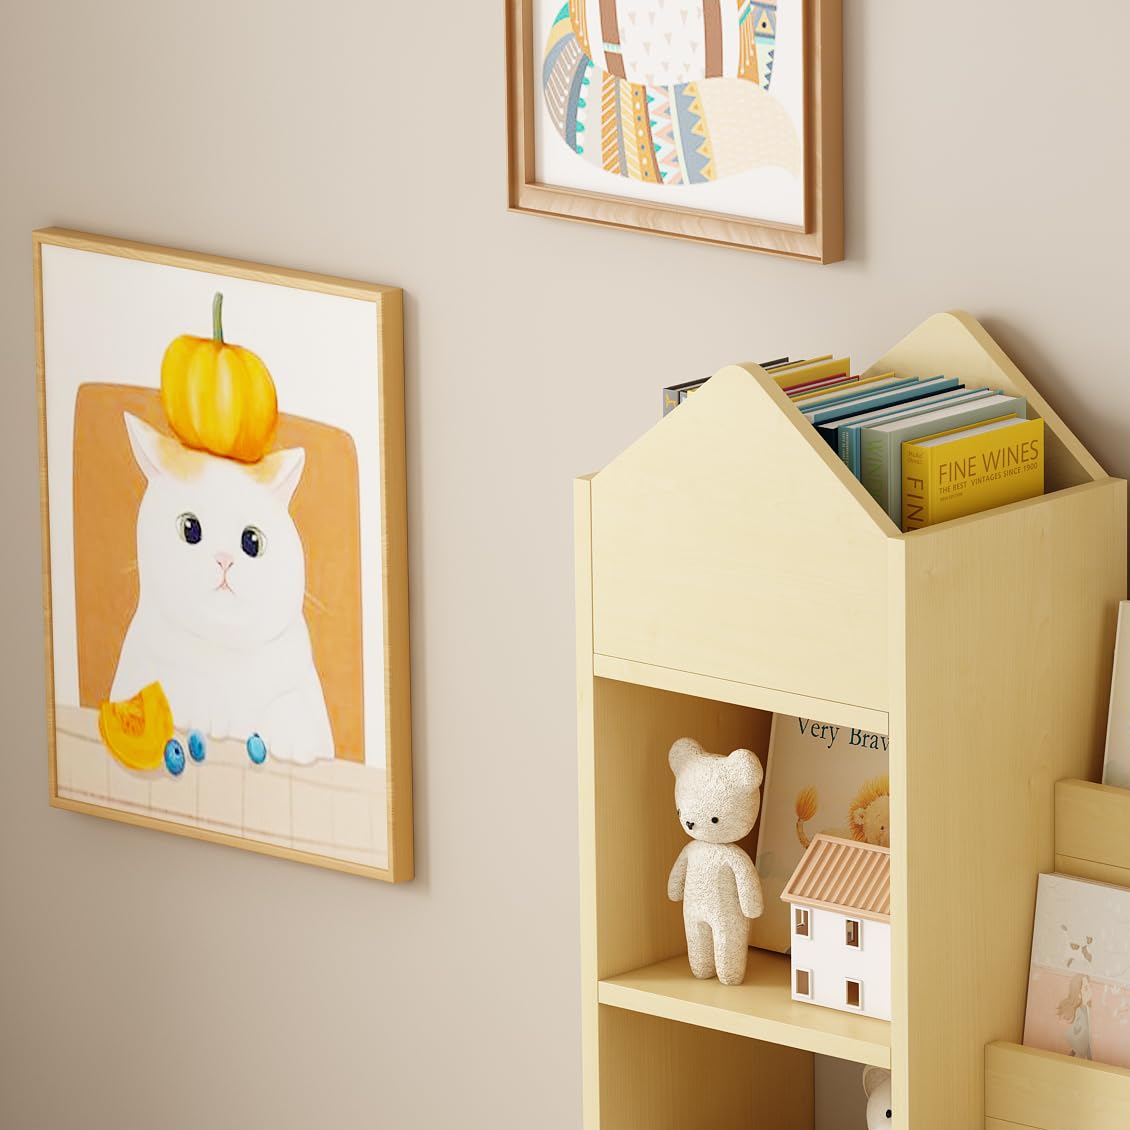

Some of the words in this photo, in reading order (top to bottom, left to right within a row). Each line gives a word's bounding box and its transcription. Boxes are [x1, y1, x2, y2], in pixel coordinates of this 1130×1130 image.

[939, 455, 977, 486] FINE
[982, 439, 1039, 473] WINES
[939, 486, 951, 494] THE
[953, 481, 967, 491] BEST
[971, 471, 1001, 487] VINTAGES
[1004, 468, 1022, 478] SINCE
[1023, 462, 1038, 472] 1900
[798, 717, 840, 749] Very
[849, 727, 889, 751] Brav
